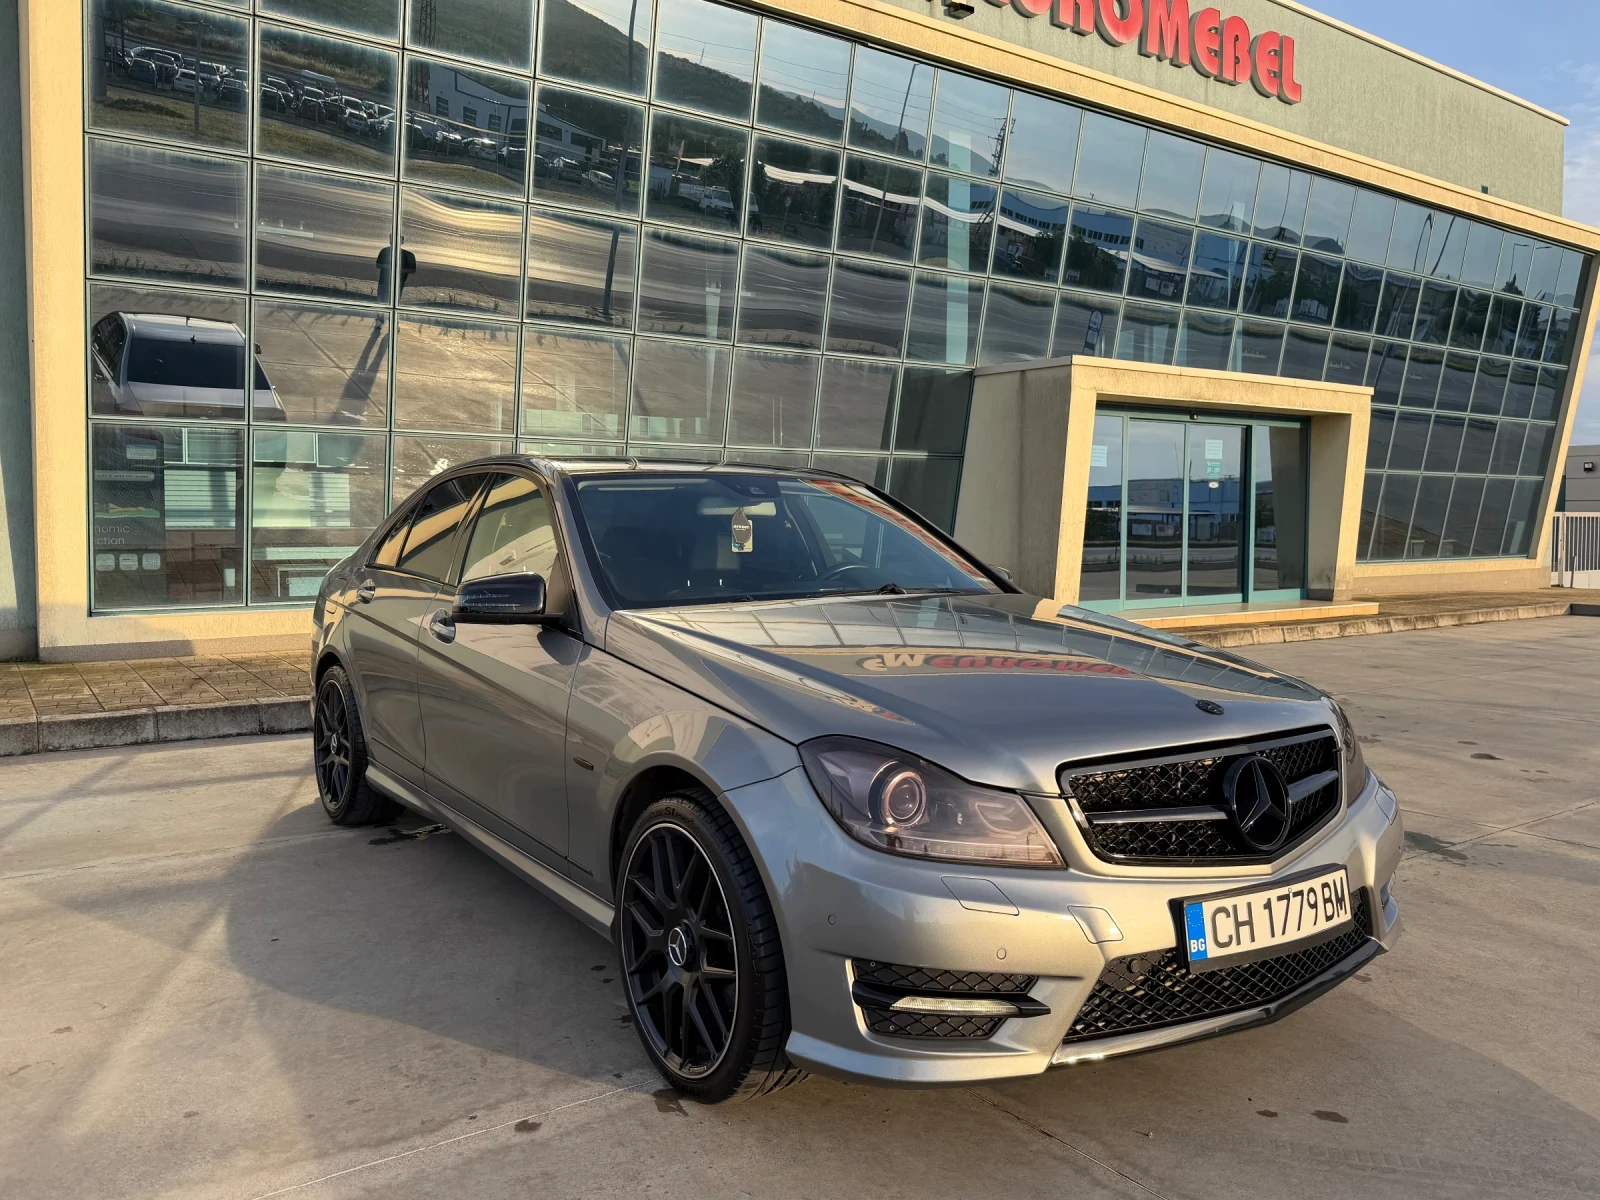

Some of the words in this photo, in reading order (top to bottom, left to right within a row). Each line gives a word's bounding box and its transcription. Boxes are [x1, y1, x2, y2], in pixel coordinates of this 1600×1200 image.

[985, 0, 1301, 103] OMEBEL
[94, 536, 125, 546] ction
[1211, 902, 1255, 948] CH
[1263, 887, 1318, 938] 1779
[1321, 876, 1347, 922] BM
[1191, 938, 1206, 953] BG
